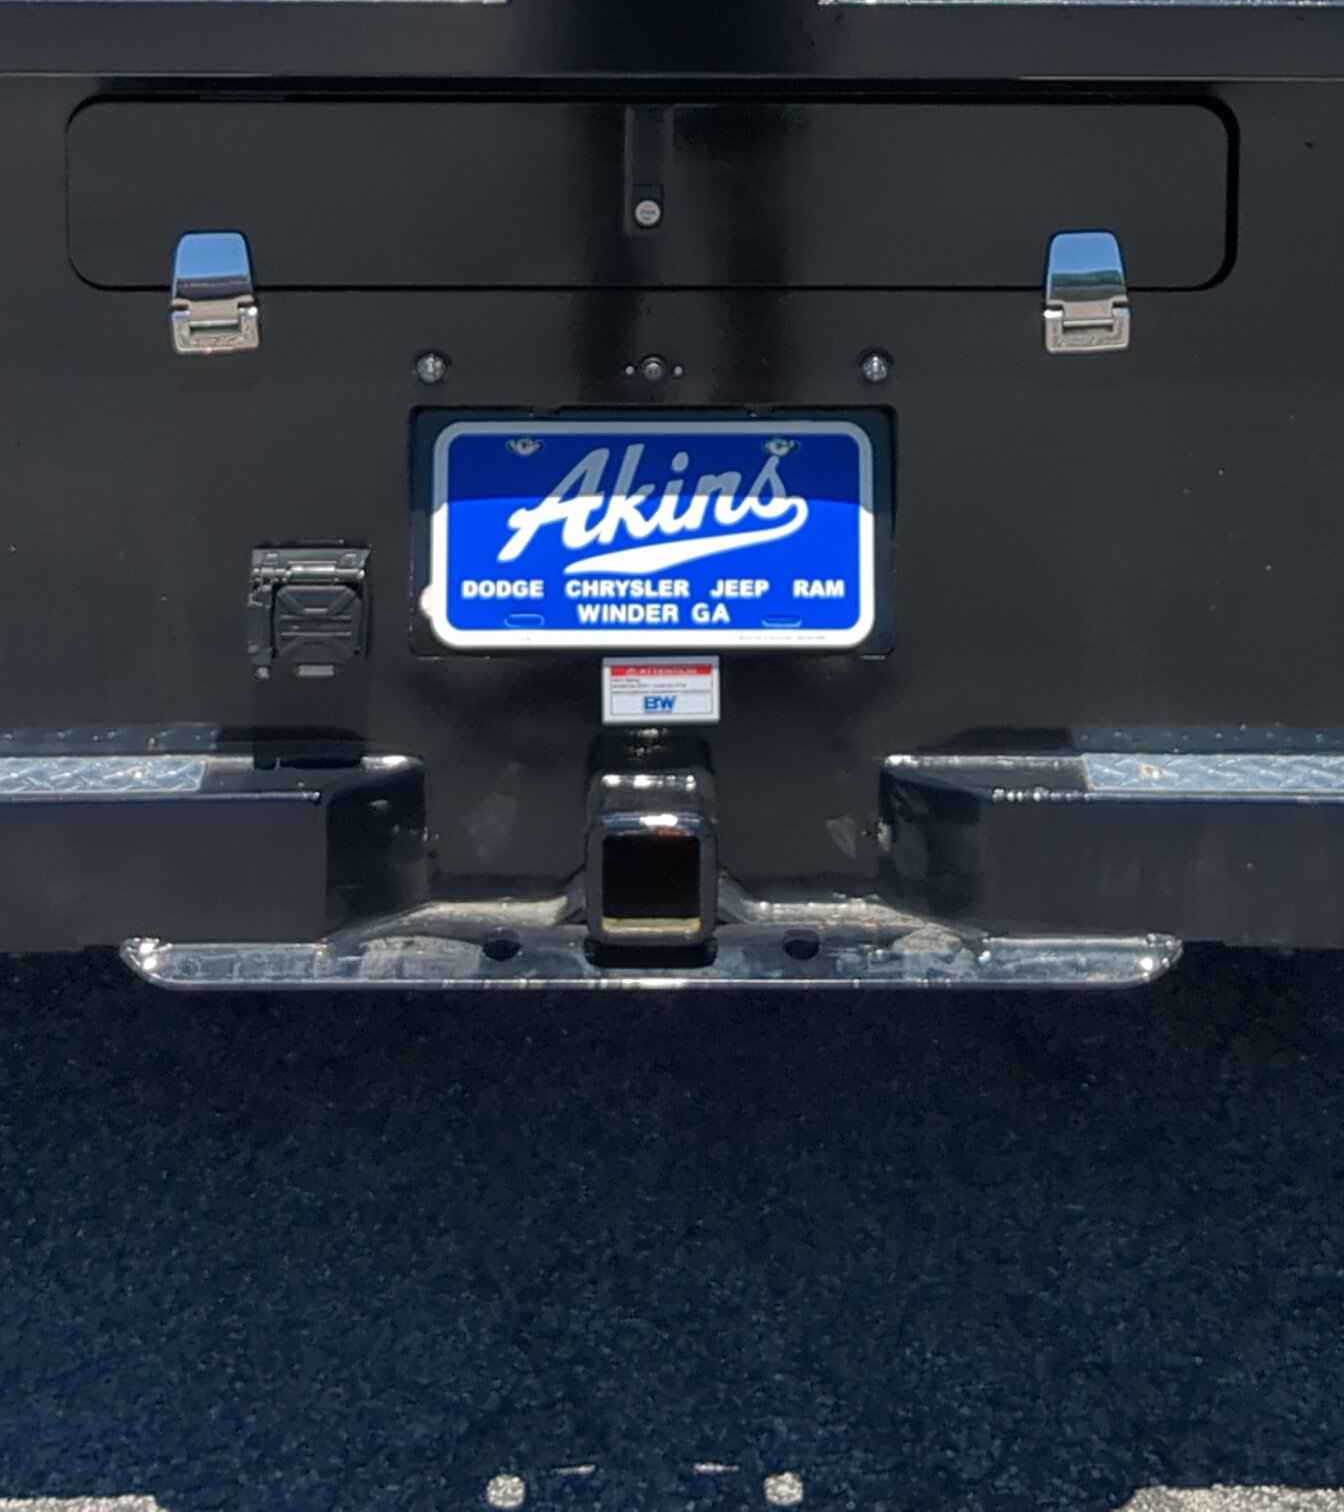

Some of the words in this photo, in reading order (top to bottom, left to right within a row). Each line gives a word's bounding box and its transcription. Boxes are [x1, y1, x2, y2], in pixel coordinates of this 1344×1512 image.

[498, 443, 806, 568] Akins
[462, 579, 544, 598] DODGE
[565, 579, 690, 598] CHRYSLER
[710, 579, 769, 598] JEEP
[793, 579, 845, 598] RAM
[578, 603, 679, 623] WINDER
[692, 603, 730, 623] GA
